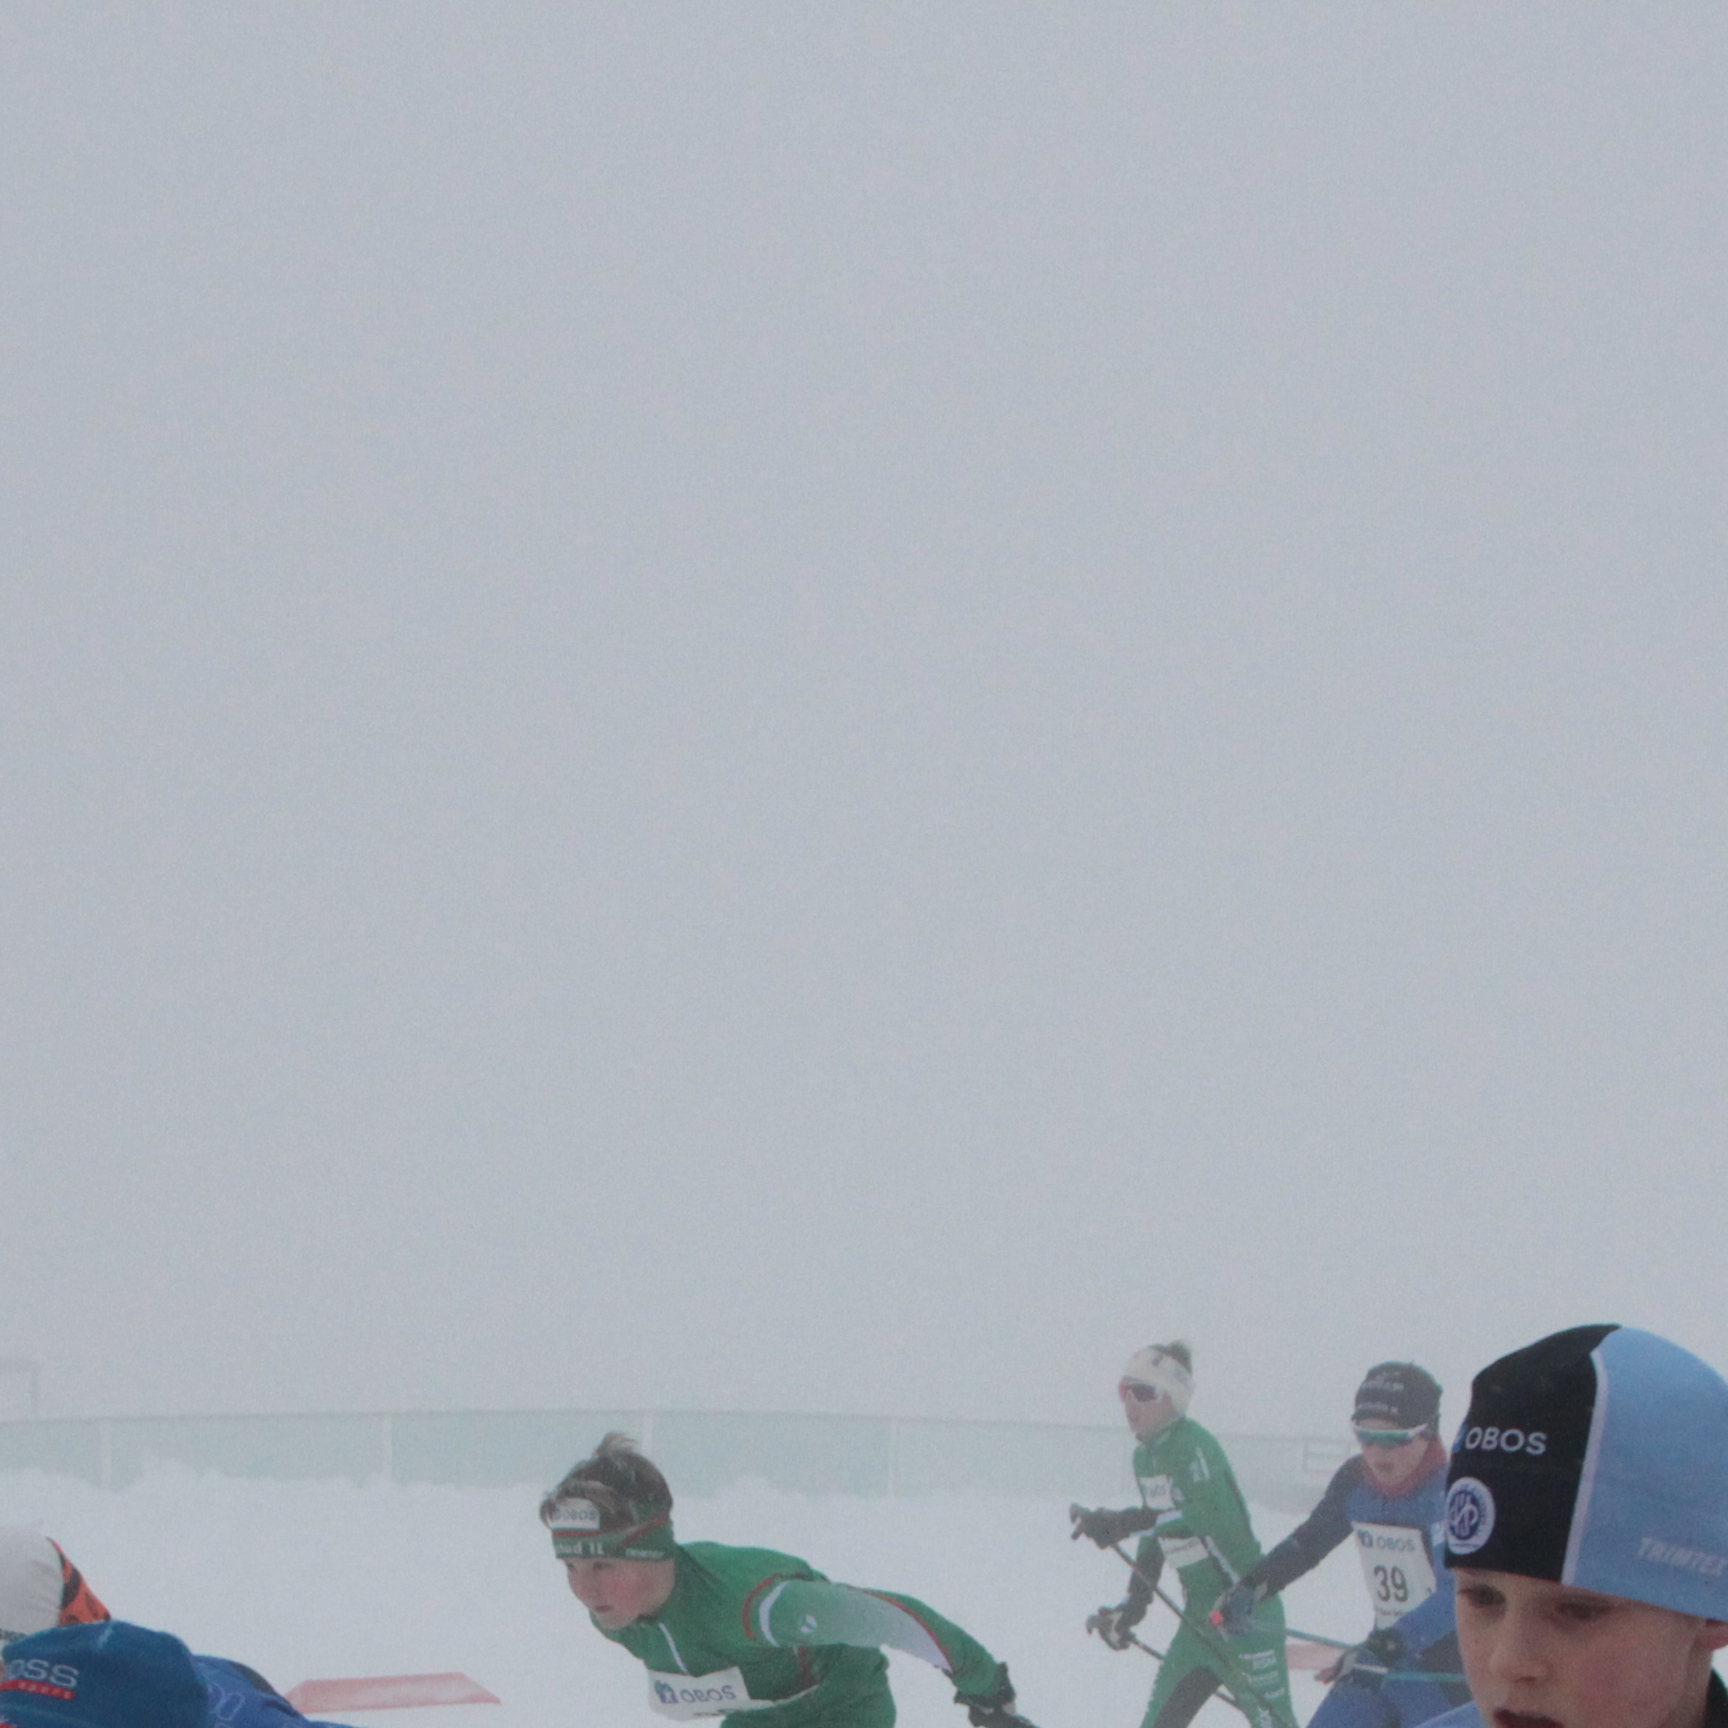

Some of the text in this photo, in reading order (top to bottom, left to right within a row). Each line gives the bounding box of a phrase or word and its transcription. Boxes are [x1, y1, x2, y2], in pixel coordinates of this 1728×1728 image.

[1465, 1427, 1548, 1455] OBOS
[1376, 1535, 1416, 1552] OBOS
[1374, 1564, 1409, 1602] 39
[680, 1684, 736, 1703] OBOS
